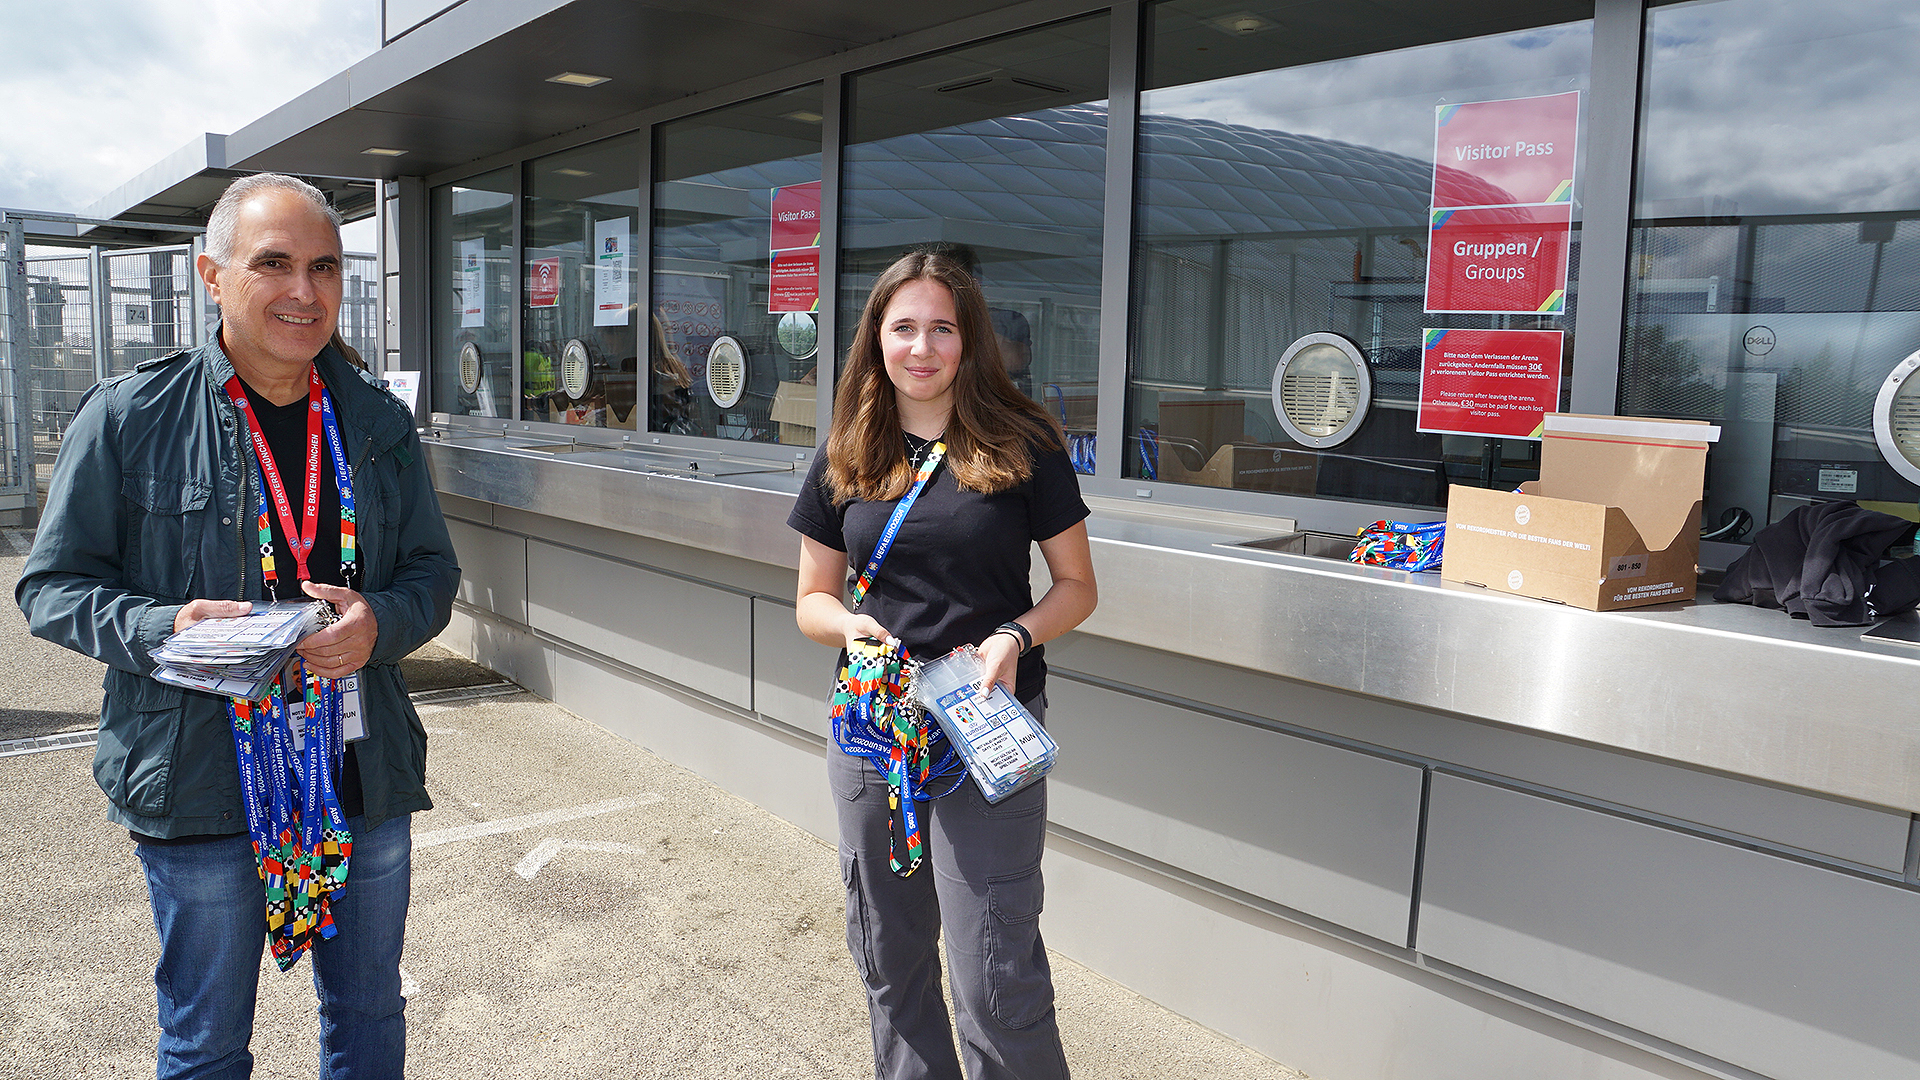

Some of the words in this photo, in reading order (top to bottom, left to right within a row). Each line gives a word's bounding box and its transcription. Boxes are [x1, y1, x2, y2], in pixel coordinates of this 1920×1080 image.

[1455, 144, 1510, 161] Visitor
[1516, 141, 1554, 157] Pass
[778, 211, 799, 222] Visitor
[800, 210, 815, 219] Pass
[1454, 241, 1527, 259] Gruppen
[1531, 236, 1542, 258] /
[1465, 264, 1525, 283] Groups
[130, 310, 146, 320] 74
[1747, 337, 1772, 345] DELL
[1528, 363, 1543, 372] 30€
[1432, 399, 1460, 407] Otherwise,
[1460, 400, 1475, 409] €30
[252, 432, 274, 471] MÜNCHEN
[269, 471, 285, 504] BAYERN
[308, 470, 317, 504] BAYERN
[280, 504, 288, 517] FC
[308, 505, 315, 516] FC
[1467, 525, 1507, 537] REKORDMEISTER
[1507, 531, 1517, 539] FÜR
[1528, 535, 1547, 544] BESTEN
[1638, 582, 1674, 592] REKORDMEISTER
[1613, 594, 1624, 602] FÜR
[1019, 733, 1036, 745] MUN
